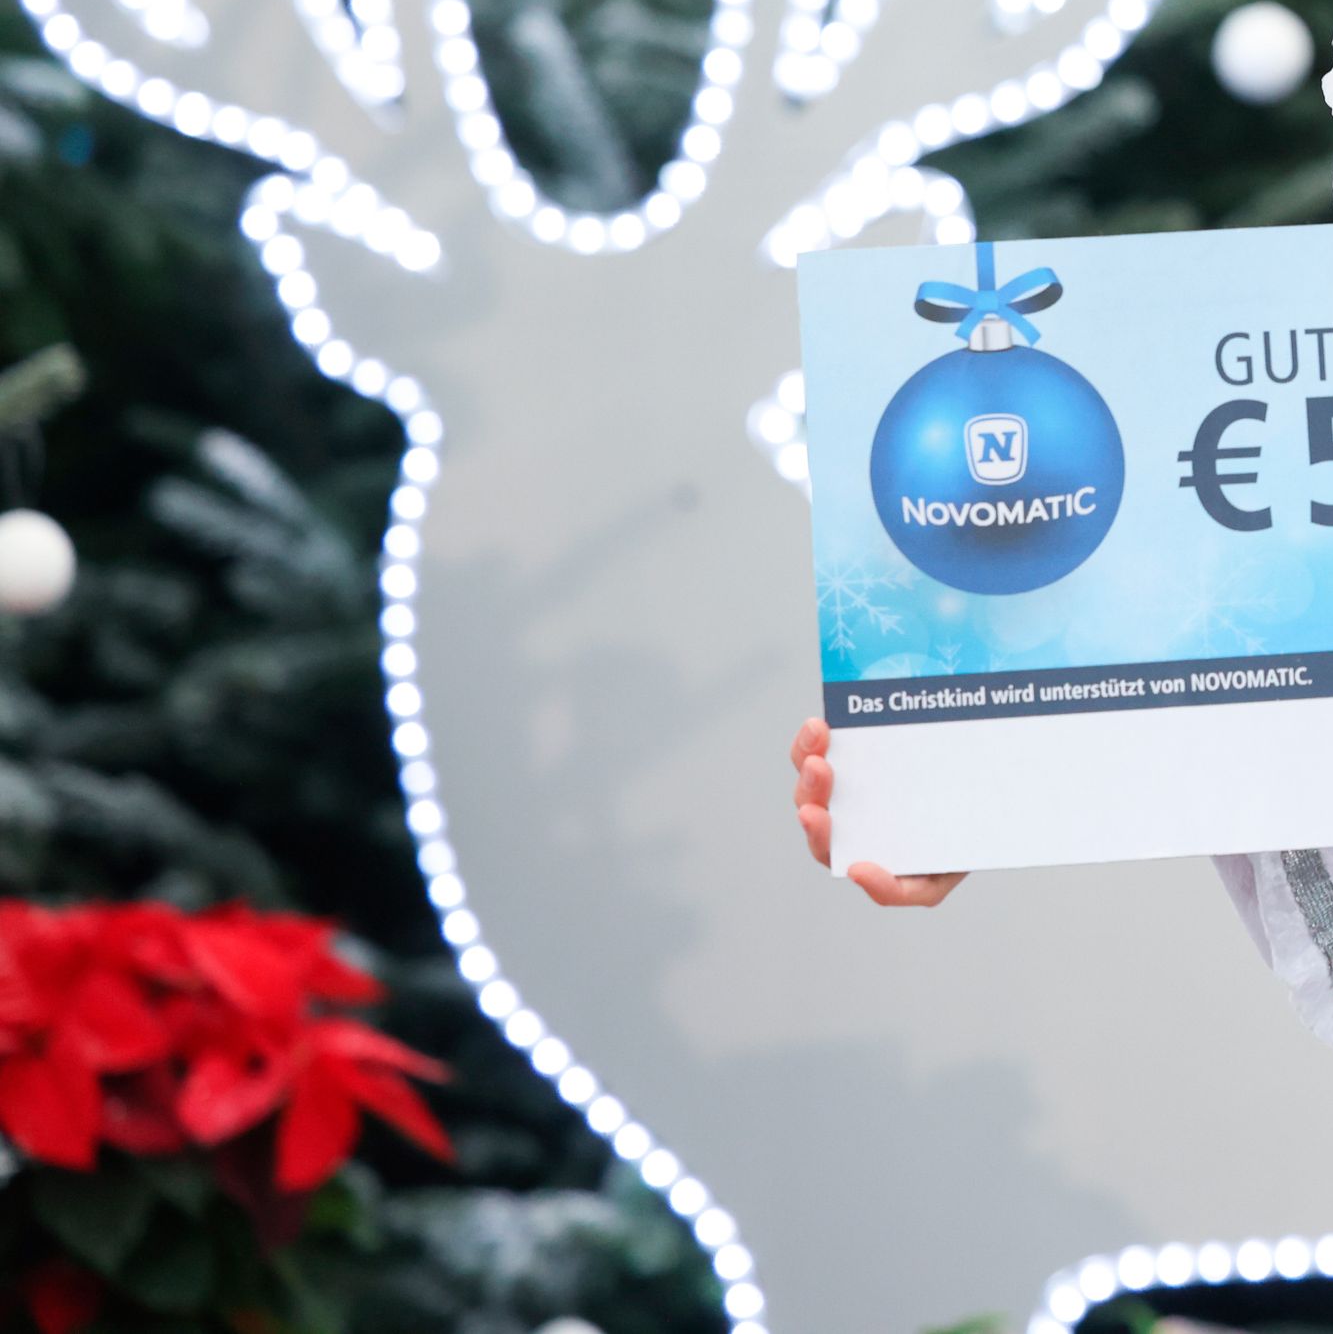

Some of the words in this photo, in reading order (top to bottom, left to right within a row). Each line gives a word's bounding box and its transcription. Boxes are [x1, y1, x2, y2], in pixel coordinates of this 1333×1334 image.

[902, 486, 1096, 526] NOVOMATIC
[848, 695, 884, 714] Das
[888, 687, 987, 712] Christkind
[990, 683, 1035, 707] wird
[1039, 677, 1145, 703] unterstützt
[1149, 677, 1186, 695] von
[1190, 666, 1313, 693] NOVOMATIC.
